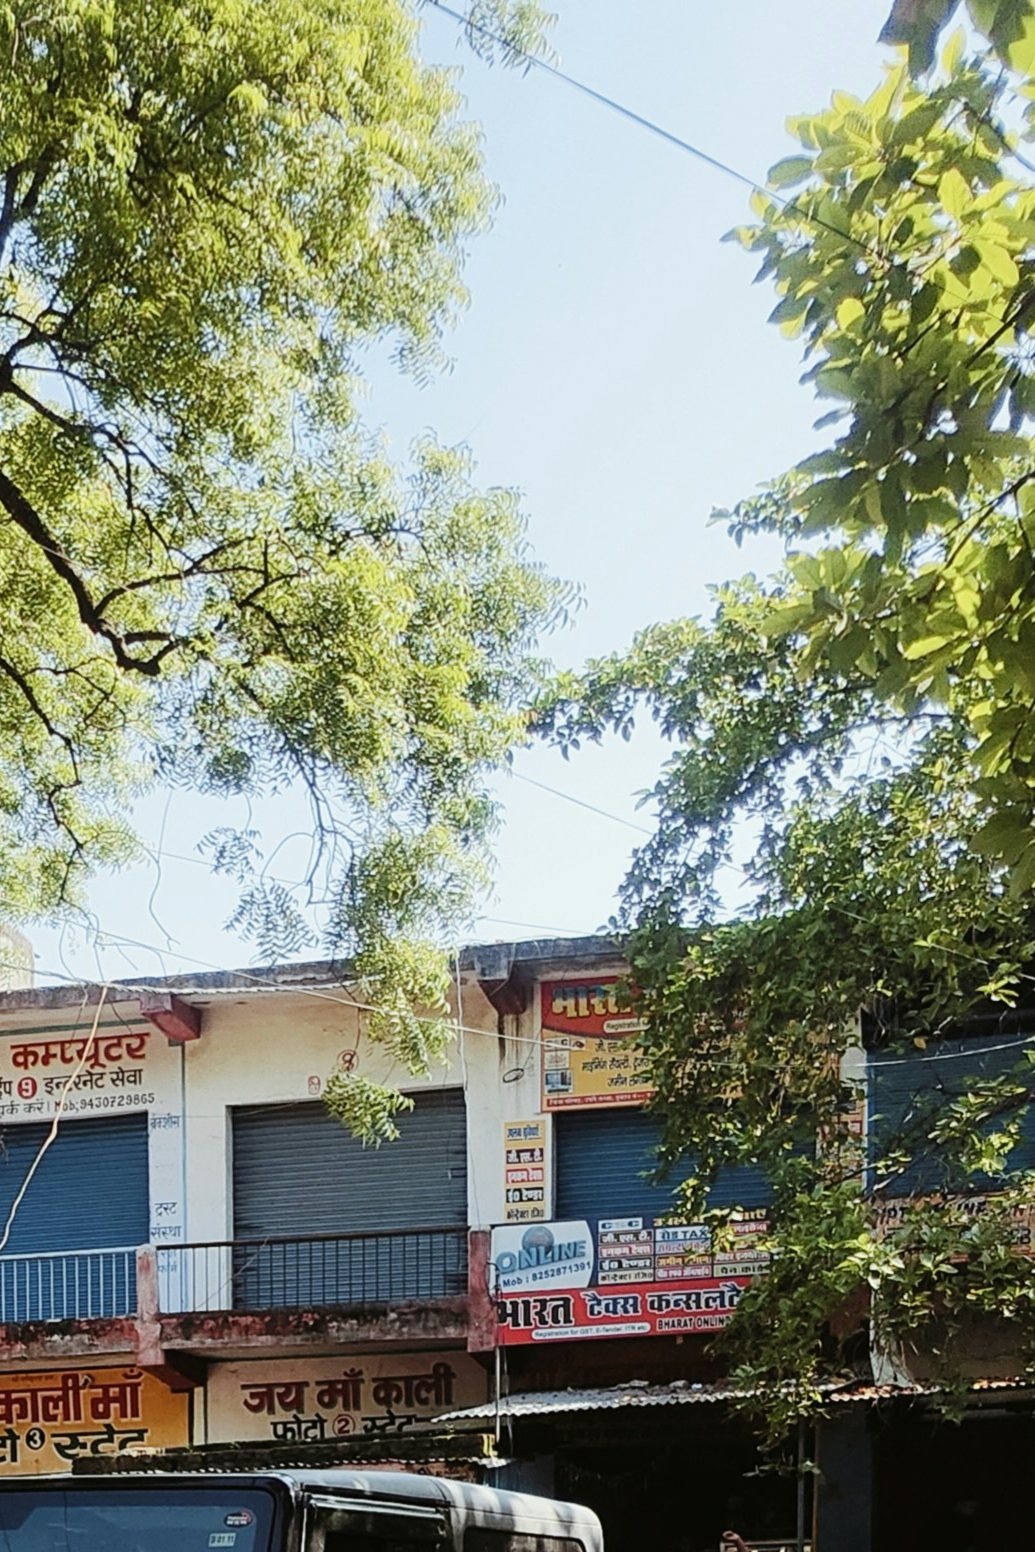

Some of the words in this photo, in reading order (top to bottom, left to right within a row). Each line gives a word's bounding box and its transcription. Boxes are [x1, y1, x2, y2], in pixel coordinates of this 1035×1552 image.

[110, 1067, 143, 1088] सेवा
[681, 1226, 708, 1239] TAX
[496, 1240, 587, 1275] ONLINE
[502, 1277, 523, 1288] Mob
[532, 1261, 592, 1282] 8252871391
[497, 1295, 573, 1328] भारत
[584, 1292, 640, 1317] टैक्स
[648, 1284, 743, 1312] कन्सलटै
[535, 1329, 570, 1339] Registration
[571, 1329, 579, 1337] for
[657, 1318, 693, 1330] BHARAT
[696, 1316, 732, 1329] ONLIN
[91, 1368, 143, 1420] माँ
[241, 1381, 310, 1415] जय
[315, 1368, 365, 1412] माँ
[371, 1362, 457, 1410] काली
[28, 1430, 43, 1448] 3
